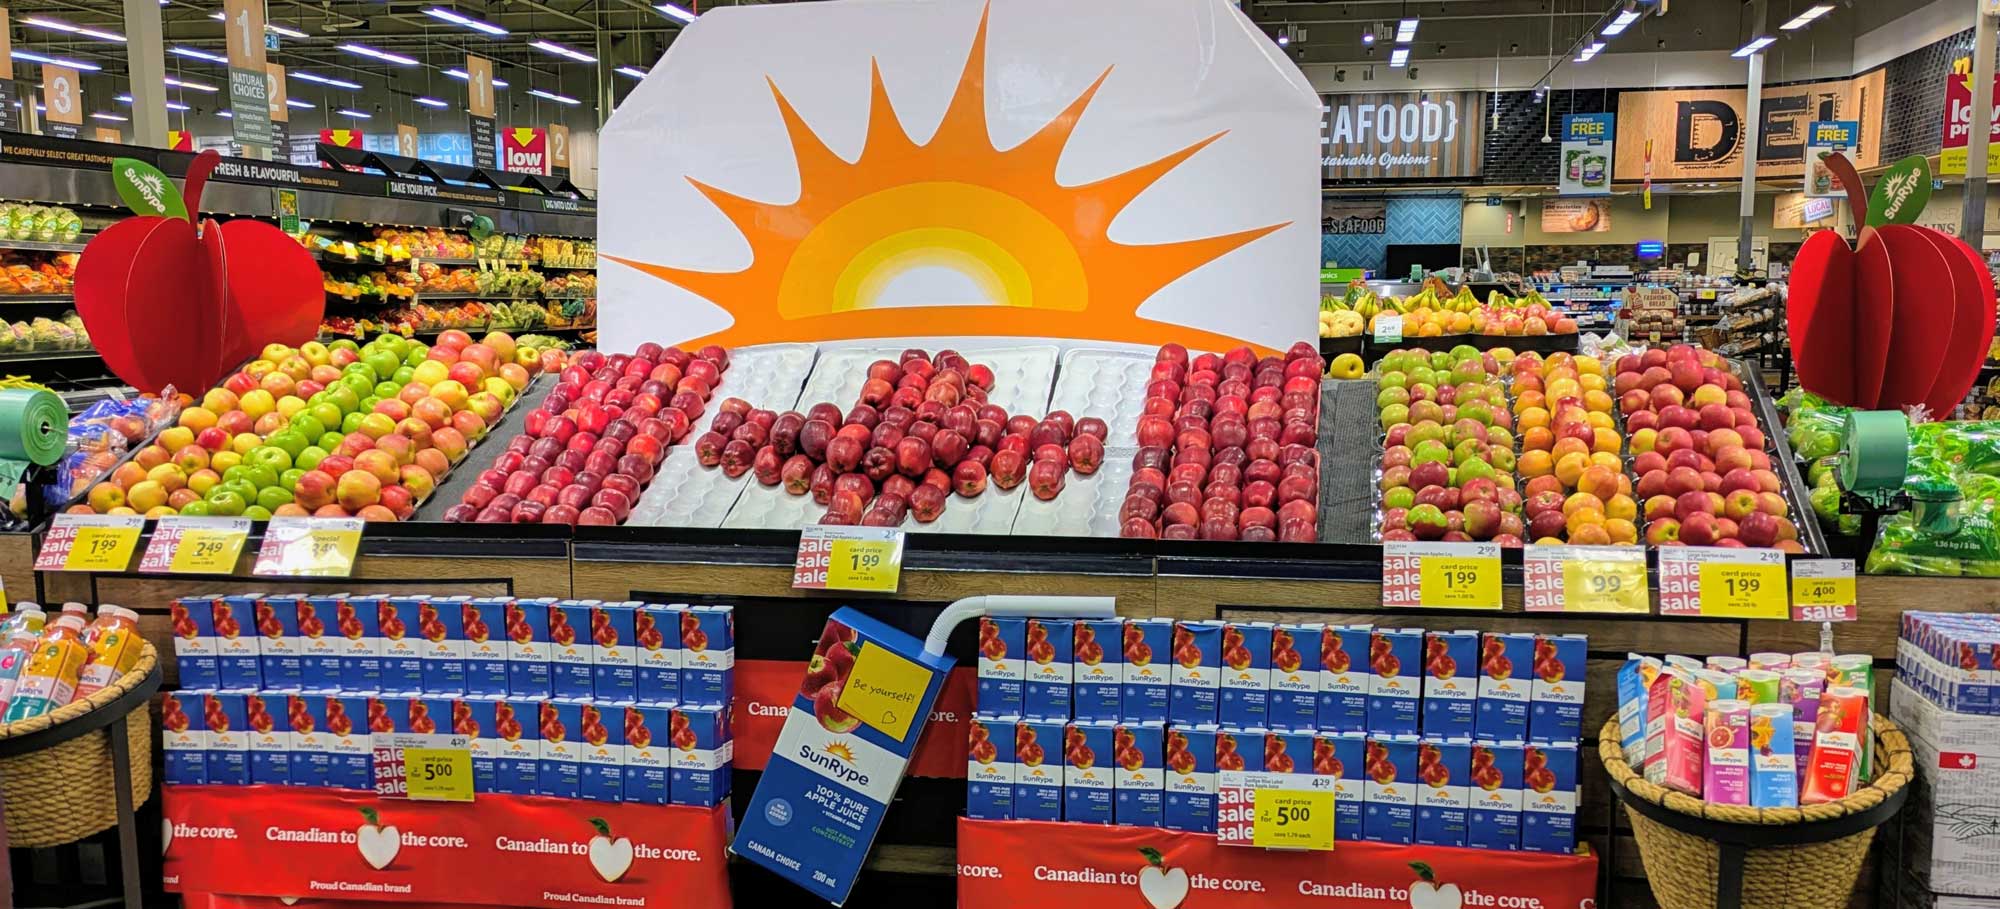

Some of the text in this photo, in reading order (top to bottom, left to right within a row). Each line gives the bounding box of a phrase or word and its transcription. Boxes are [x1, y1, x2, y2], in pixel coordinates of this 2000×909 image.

[237, 9, 251, 57] 1
[232, 72, 264, 88] NATURAL
[53, 76, 72, 114] 3
[233, 83, 265, 100] CHOICES
[475, 69, 485, 108] 1
[1320, 100, 1458, 144] EAFOOD}
[1571, 122, 1605, 136] FREE
[1816, 129, 1849, 141] FREE
[3, 146, 13, 154] WE
[14, 147, 46, 157] CAREFULLY
[46, 150, 66, 159] SELECT
[67, 152, 84, 161] GREAT
[554, 133, 565, 161] 2
[507, 147, 543, 166] low
[1378, 151, 1430, 170] Options
[215, 162, 301, 183] FRESH & FLAVOURFUL
[508, 166, 543, 175] prices
[123, 166, 166, 214] SunRype
[391, 182, 437, 196] TAKE YOUR PICK
[1883, 166, 1922, 220] SunRype
[1331, 219, 1385, 234] SEAFOOD
[47, 528, 78, 539] sale
[153, 529, 185, 540] sale
[41, 539, 73, 553] sale
[147, 541, 178, 554] sale
[799, 540, 832, 552] sale
[35, 553, 68, 566] sale
[141, 555, 173, 567] sale
[797, 554, 830, 568] sale
[1383, 556, 1421, 570] sale
[1524, 560, 1562, 574] sale
[794, 569, 828, 584] sale
[1661, 562, 1700, 576] sale
[1383, 571, 1421, 586] sale
[1525, 576, 1563, 591] sale
[1660, 577, 1700, 593] sale
[1383, 587, 1421, 602] sale
[1525, 591, 1565, 607] sale
[1660, 594, 1700, 610] sale
[1802, 605, 1846, 621] sale
[1130, 674, 1162, 683] SunRype
[1179, 677, 1211, 686] SunRype
[1229, 679, 1261, 688] SunRype
[1278, 681, 1311, 690] SunRype
[853, 679, 915, 704] Be yourself!
[1327, 683, 1361, 691] SunRype
[1376, 687, 1410, 696] SunRype
[1433, 688, 1467, 698] SunRype
[1487, 689, 1521, 699] SunRype
[1541, 692, 1575, 701] SunRype
[929, 711, 958, 722] ore.
[373, 748, 404, 762] sale
[374, 763, 406, 778] sale
[799, 745, 870, 787] SunRype
[975, 773, 1006, 782] SunRype
[1022, 775, 1053, 784] SunRype
[1074, 777, 1104, 787] SunRype
[1123, 779, 1155, 788] SunRype
[376, 779, 408, 794] sale
[1173, 782, 1206, 792] SunRype
[816, 784, 869, 815] 100% PURE
[1218, 788, 1255, 804] sale
[1373, 792, 1406, 802] SunRype
[1426, 797, 1459, 806] SunRype
[804, 790, 865, 823] APPLE JUICE
[1479, 799, 1513, 809] SunRype
[1531, 801, 1566, 810] SunRype
[1218, 805, 1254, 822] sale
[174, 823, 238, 839] the core.
[266, 826, 468, 848] Canadian to the core.
[1217, 824, 1254, 841] sale
[496, 836, 701, 862] Canadian to the core.
[748, 840, 801, 871] CANADA CHOICE
[812, 870, 837, 888] 200 mL
[963, 865, 1003, 878] core.
[1034, 866, 1266, 892] Canadian to the core.
[310, 880, 412, 893] Proud Canadian brand
[543, 891, 645, 907] Proud Canadian brand
[1298, 880, 1544, 909] Canadian to the core.
